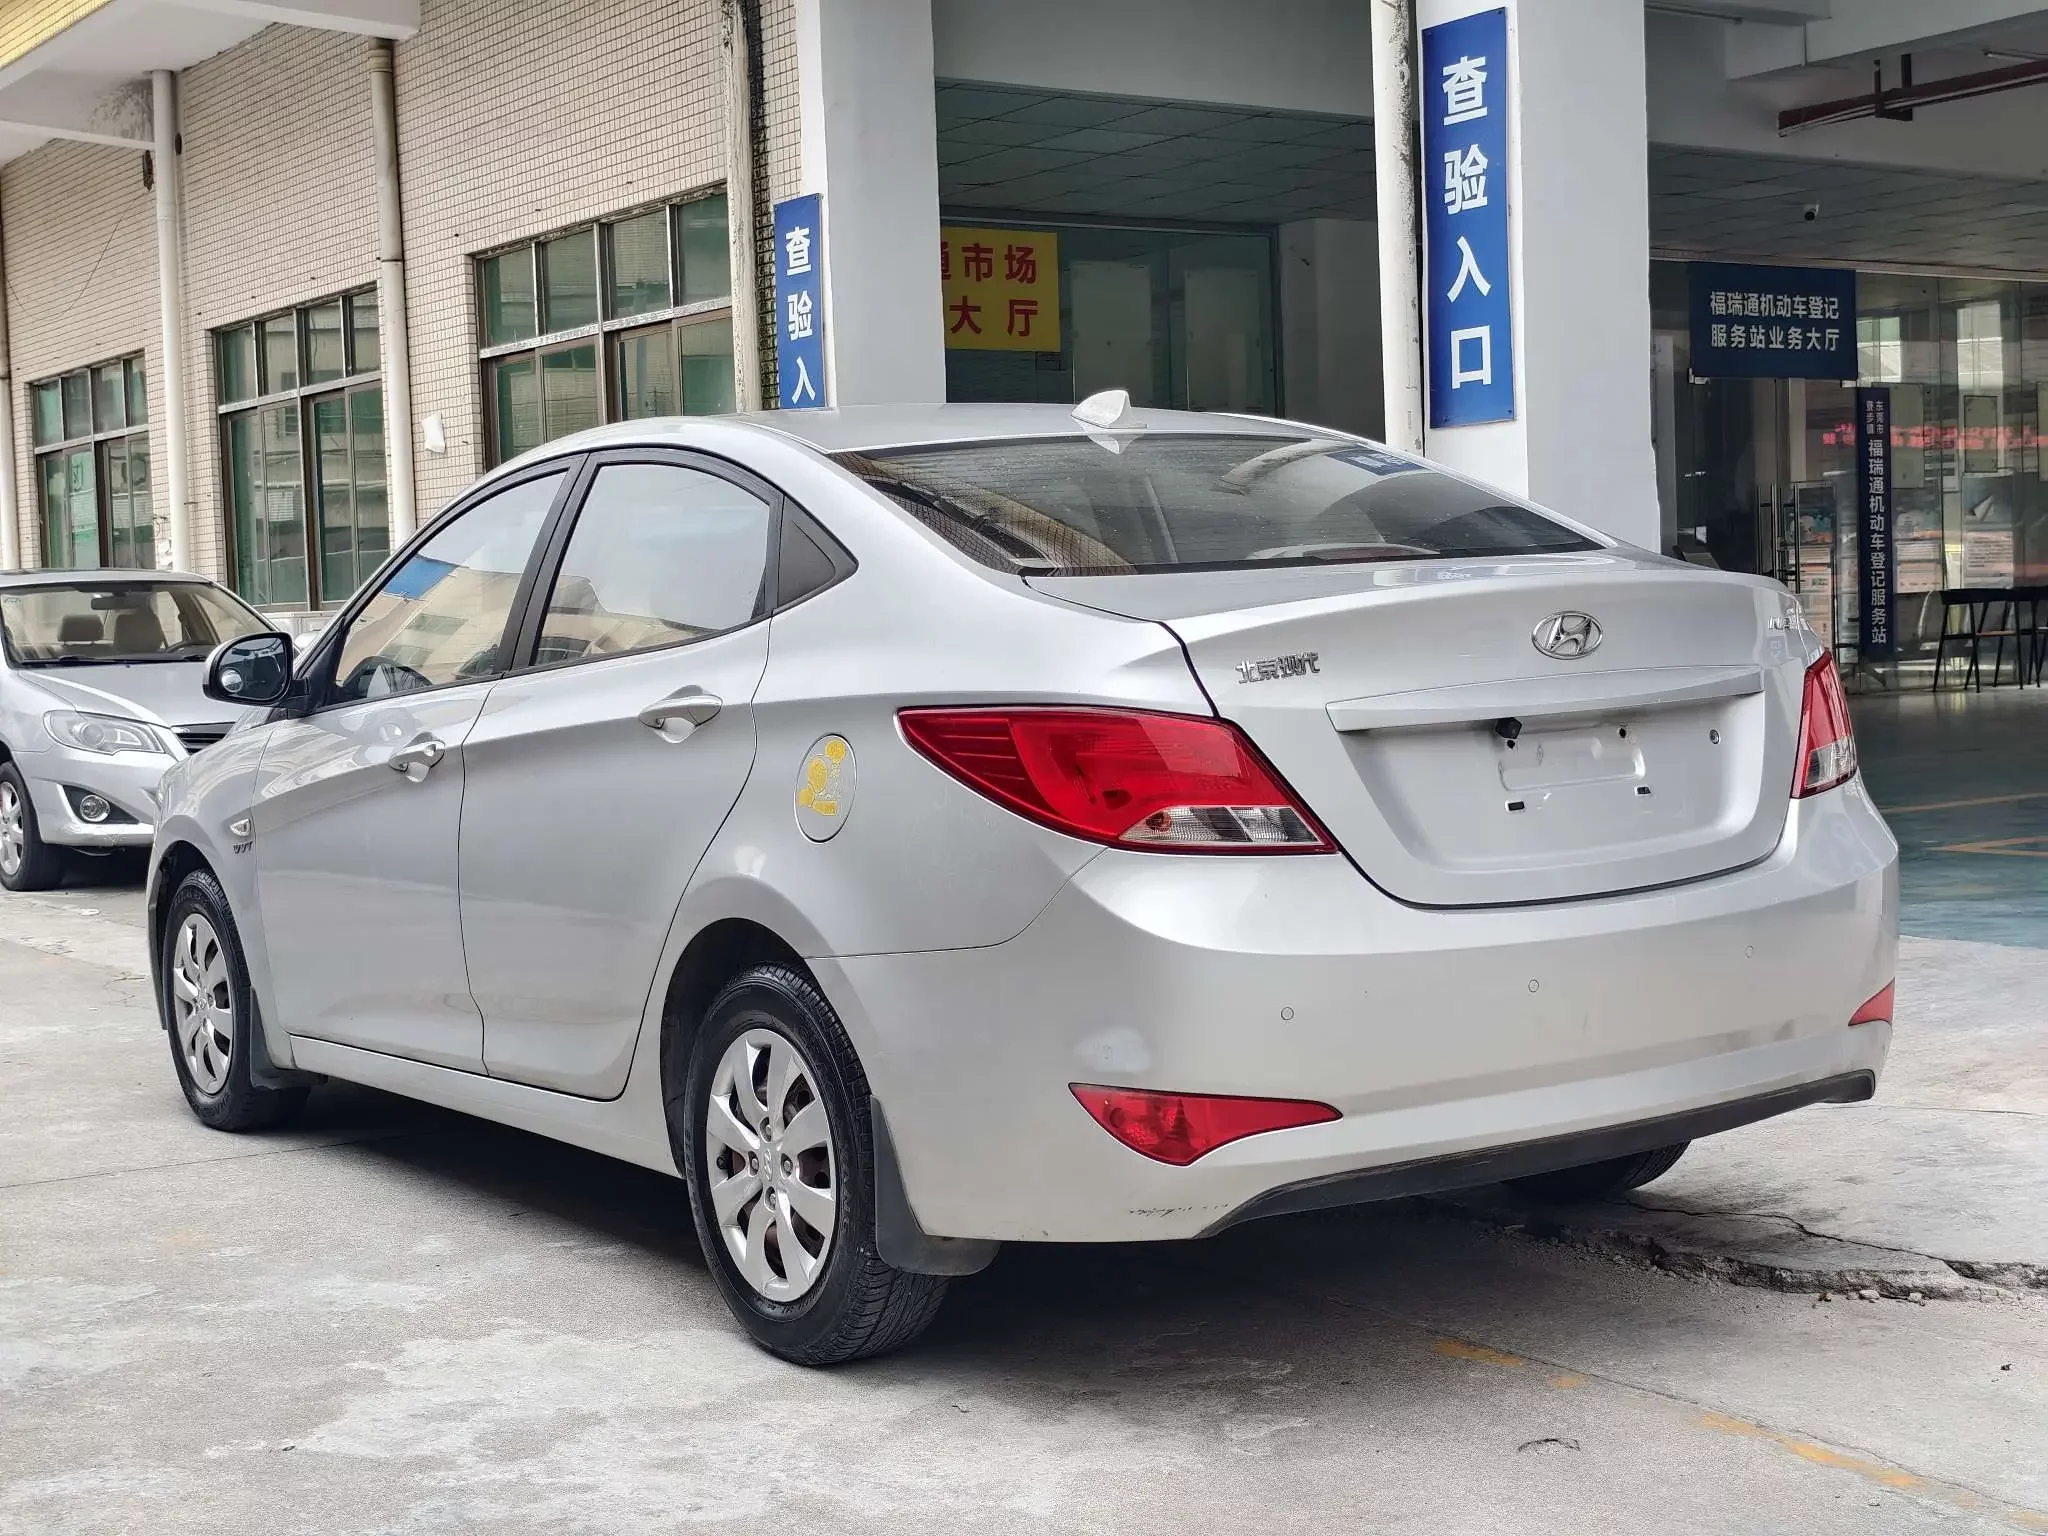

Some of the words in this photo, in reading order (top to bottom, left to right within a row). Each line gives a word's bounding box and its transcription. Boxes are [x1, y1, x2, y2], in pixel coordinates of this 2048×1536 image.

[1442, 56, 1492, 390] 查验入口
[785, 226, 817, 404] 查验入
[949, 295, 1038, 337] 大厅
[1710, 291, 1840, 319] 福瑞通机动车登记
[1711, 324, 1840, 351] 服务站业务大厅
[1868, 439, 1887, 644] 福瑞通机动车登记服务站
[1235, 651, 1320, 684] 北京现代
